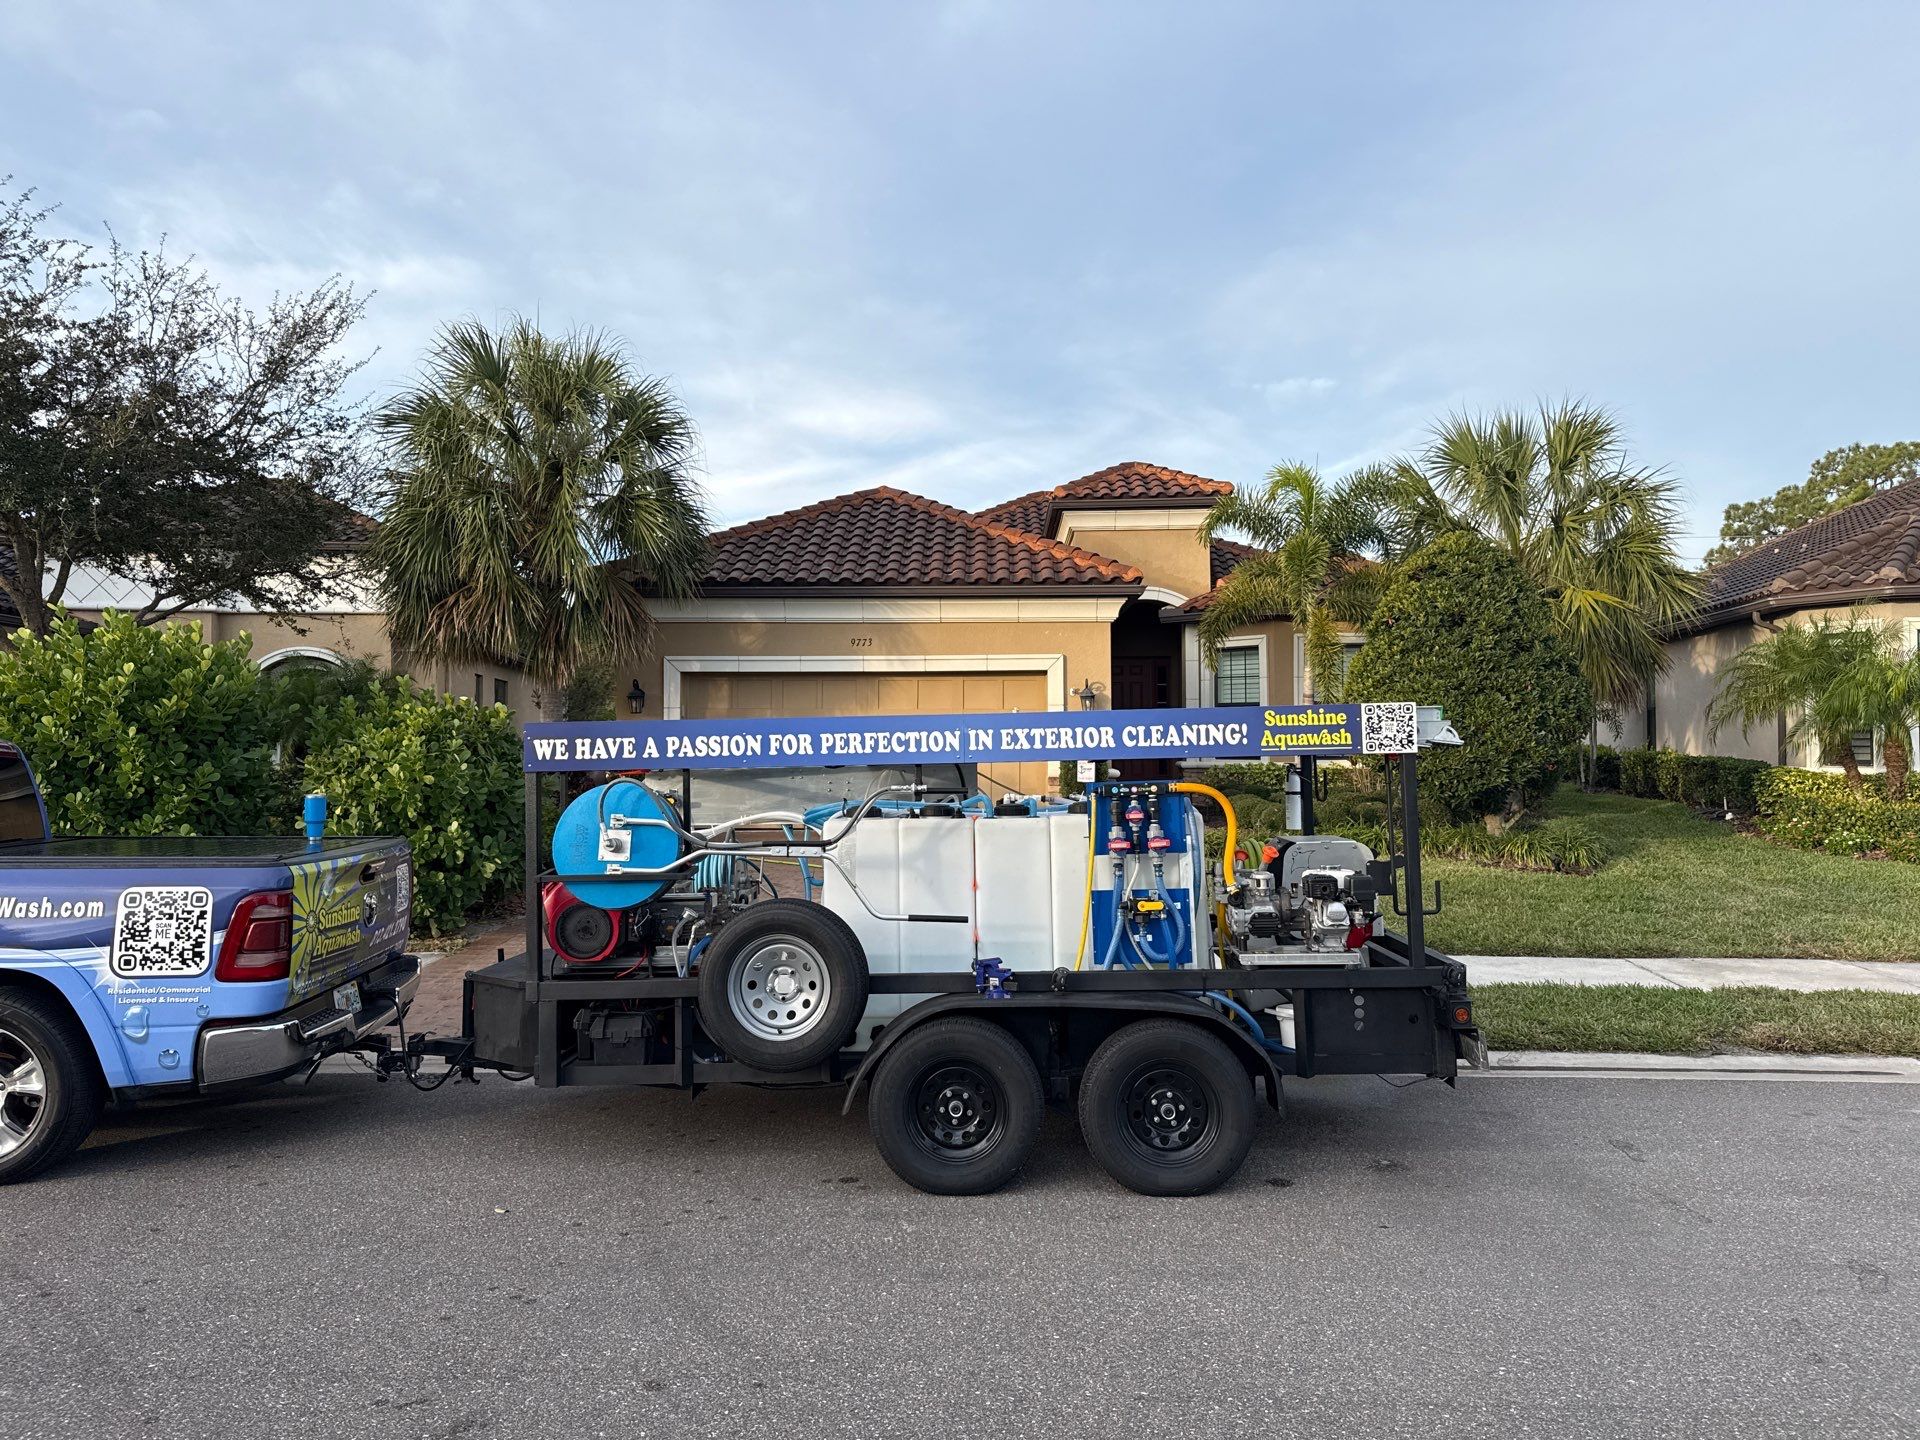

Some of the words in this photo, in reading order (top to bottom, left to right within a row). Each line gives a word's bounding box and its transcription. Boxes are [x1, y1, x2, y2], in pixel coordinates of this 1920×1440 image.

[850, 638, 873, 647] 9773
[1264, 708, 1347, 726] Sunshine
[533, 738, 569, 761] WE
[575, 736, 636, 760] HAVE
[642, 736, 660, 759] A
[665, 733, 762, 758] PASSION
[768, 731, 814, 756] FOR
[819, 729, 961, 755] PERFECTION
[968, 727, 993, 752] IN
[1000, 725, 1116, 750] EXTERIOR
[1122, 721, 1249, 748] CLEANING!
[1260, 728, 1352, 750] Aquawash
[319, 902, 361, 930] Sunshine
[155, 928, 171, 939] ME
[314, 925, 361, 957] Aquawash
[107, 986, 211, 995] Residential/Commercial
[118, 996, 157, 1004] Licensed
